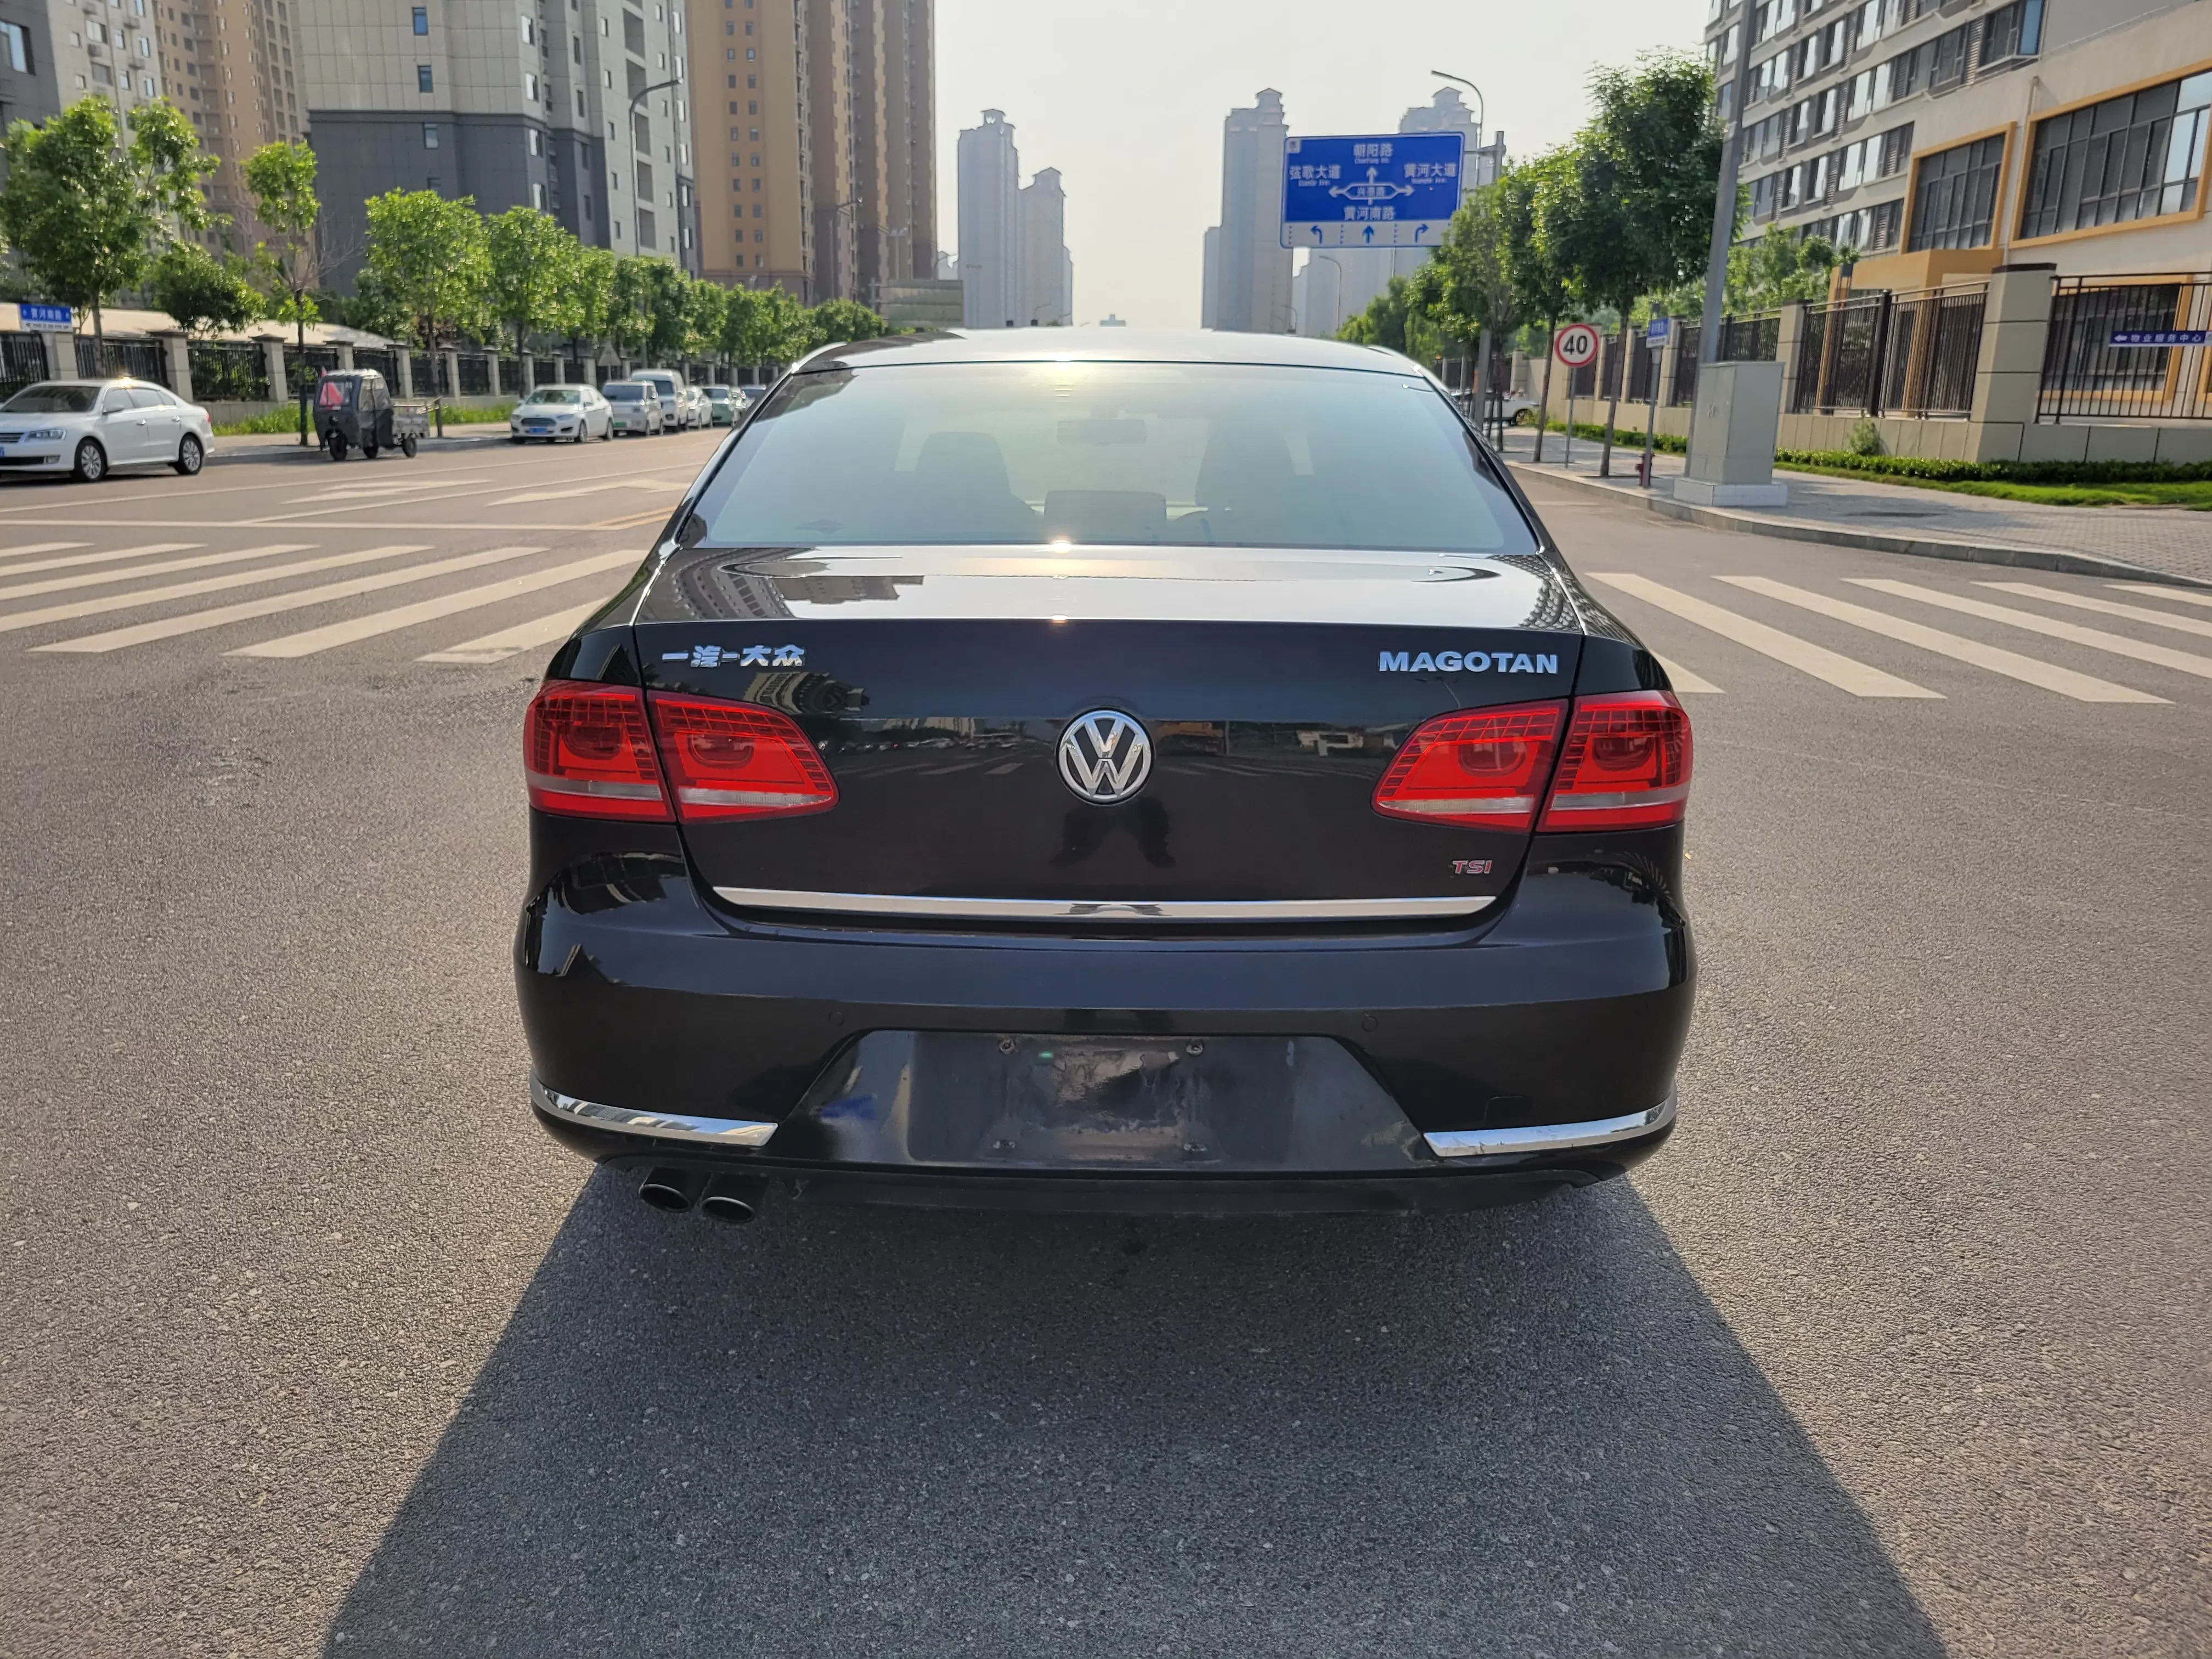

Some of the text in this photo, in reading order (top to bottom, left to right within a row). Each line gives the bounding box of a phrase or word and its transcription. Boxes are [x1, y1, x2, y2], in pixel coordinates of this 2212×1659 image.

[1353, 143, 1393, 157] 朝阳路
[1404, 162, 1456, 177] 黄河大道
[1344, 206, 1396, 220] 黄河南路
[1564, 335, 1587, 354] 40
[2130, 334, 2201, 342] 物业服务中心
[1379, 651, 1558, 674] MAGOTAN
[1452, 860, 1492, 874] TSI
